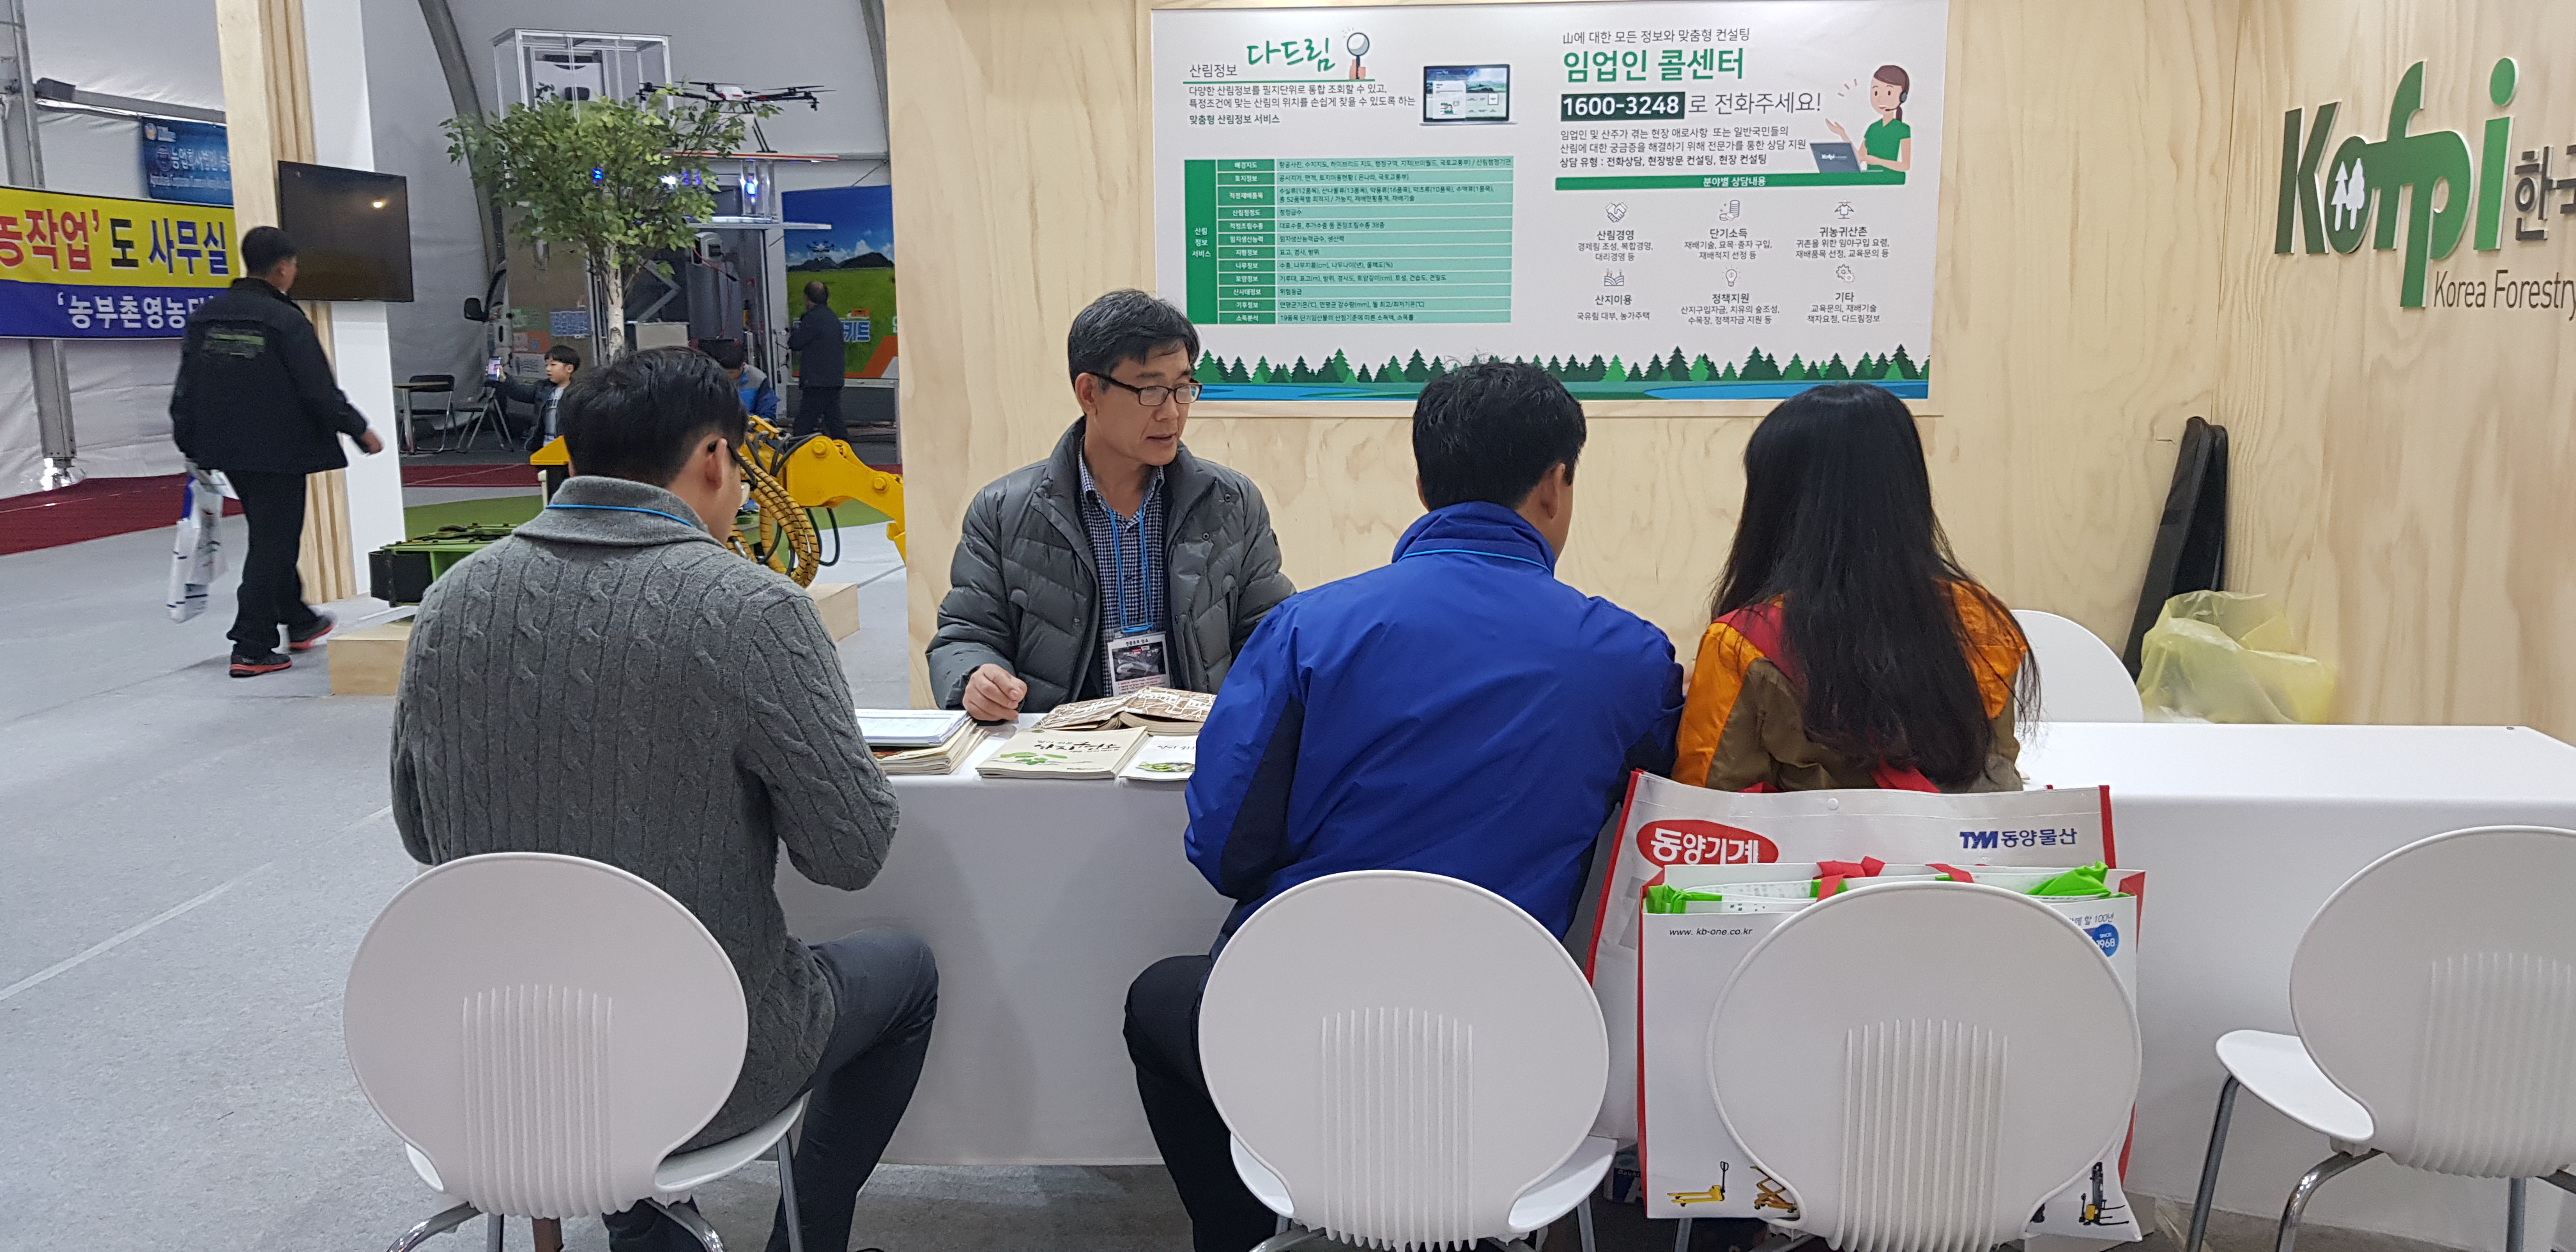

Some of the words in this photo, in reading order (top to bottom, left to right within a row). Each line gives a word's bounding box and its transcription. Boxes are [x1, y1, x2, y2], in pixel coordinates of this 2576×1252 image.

[1563, 31, 1584, 44] 山에
[1589, 31, 1611, 44] 대한
[1614, 31, 1637, 43] 모든
[1641, 29, 1675, 43] 정보와
[1678, 29, 1712, 42] 맞춤형
[1716, 28, 1749, 42] 컨설팅
[1190, 64, 1238, 78] 산림정보
[1246, 38, 1335, 72] 다드림
[1564, 50, 1646, 83] 임업인
[1658, 48, 1743, 81] 콜센터
[1189, 86, 1215, 96] 다양한
[1217, 86, 1261, 96] 산림정보를
[1262, 85, 1306, 95] 필지단위로
[1308, 84, 1325, 95] 통합
[1328, 84, 1354, 95] 조회할
[1356, 85, 1365, 94] 수
[1367, 84, 1387, 94] 있고,
[1189, 98, 1232, 109] 특정조건에
[1234, 98, 1252, 109] 맞는
[1254, 98, 1280, 108] 산림의
[1282, 97, 1308, 108] 위치를
[1310, 97, 1336, 107] 손쉽게
[1339, 97, 1356, 107] 찾을
[1358, 98, 1367, 107] 수
[1370, 96, 1396, 107] 있도록
[1399, 96, 1416, 107] 하는
[1563, 96, 1680, 116] 1600-3248
[1689, 95, 1708, 113] 로
[1715, 92, 1820, 115] 전화주세요!
[1190, 115, 1215, 125] 맞춤형
[1217, 114, 1252, 125] 산림정보
[1254, 114, 1280, 125] 서비스
[1561, 130, 1587, 141] 임업인
[1590, 130, 1598, 140] 및
[1601, 129, 1628, 140] 산주가
[1631, 128, 1648, 139] 겪는
[1652, 128, 1669, 139] 현장
[1671, 128, 1708, 139] 애로사항
[1713, 127, 1731, 138] 또는
[1734, 126, 1788, 137] 일반국민들의
[1560, 143, 1587, 154] 산림에
[1590, 142, 1607, 153] 대한
[1609, 142, 1646, 153] 궁금증을
[1648, 141, 1684, 153] 해결하기
[1687, 141, 1705, 152] 위해
[1708, 141, 1744, 151] 전문가를
[1746, 140, 1765, 151] 통한
[1767, 139, 1785, 151] 상담
[1788, 139, 1806, 150] 지원
[1560, 157, 1577, 168] 상담
[1580, 156, 1597, 168] 유형
[1606, 156, 1644, 167] 전화상담,
[1648, 156, 1683, 167] 현장방문
[1686, 155, 1716, 166] 컨설팅,
[1719, 155, 1736, 165] 현장
[1740, 154, 1767, 165] 컨설팅
[1703, 177, 1729, 187] 분야별
[1731, 176, 1767, 187] 상담내용
[2274, 57, 2519, 308] Kofpi
[1195, 227, 1208, 236] 산림
[1597, 230, 1634, 241] 산림경영
[1710, 228, 1747, 239] 단기소득
[1819, 226, 1867, 238] 귀농귀산촌
[110, 218, 139, 269] 도
[148, 218, 229, 276] 사무실
[1195, 238, 1208, 247] 정보
[1577, 243, 1600, 252] 경제림
[1602, 243, 1619, 251] 조성,
[1755, 240, 1772, 249] 구입,
[1796, 239, 1819, 248] 귀촌을
[1821, 239, 1837, 248] 위한
[1839, 238, 1869, 248] 임야구입
[1872, 238, 1890, 247] 요령,
[1595, 253, 1625, 261] 대리경영
[1627, 252, 1635, 261] 등
[1699, 251, 1729, 260] 재배적지
[1731, 251, 1747, 260] 선정
[1749, 250, 1756, 260] 등
[1795, 250, 1826, 259] 재배품목
[1828, 250, 1846, 259] 선정,
[1848, 249, 1879, 258] 교육문의
[1882, 248, 1889, 258] 등
[2434, 271, 2486, 308] Korea
[1595, 294, 1632, 305] 산지이용
[1712, 293, 1749, 304] 정책지원
[1835, 291, 1855, 303] 기타
[1681, 305, 1728, 315] 산지구입자금,
[1730, 305, 1753, 314] 치유의
[1811, 304, 1844, 313] 교육문의,
[1846, 304, 1877, 313] 재배기술
[1577, 312, 1598, 321] 국유림
[1601, 312, 1618, 321] 대부,
[1620, 311, 1650, 321] 농가주택
[1688, 316, 1712, 325] 수목장,
[1715, 316, 1745, 325] 정책자금
[1747, 316, 1762, 324] 지원
[1765, 316, 1772, 324] 등
[1842, 314, 1880, 323] 다드림정보
[1959, 831, 1998, 849] TYM
[2001, 828, 2077, 847] 동양물산
[1650, 827, 1759, 864] 동양기계
[1696, 928, 1752, 936] kb-one.co.kr
[2096, 938, 2115, 949] 1968
